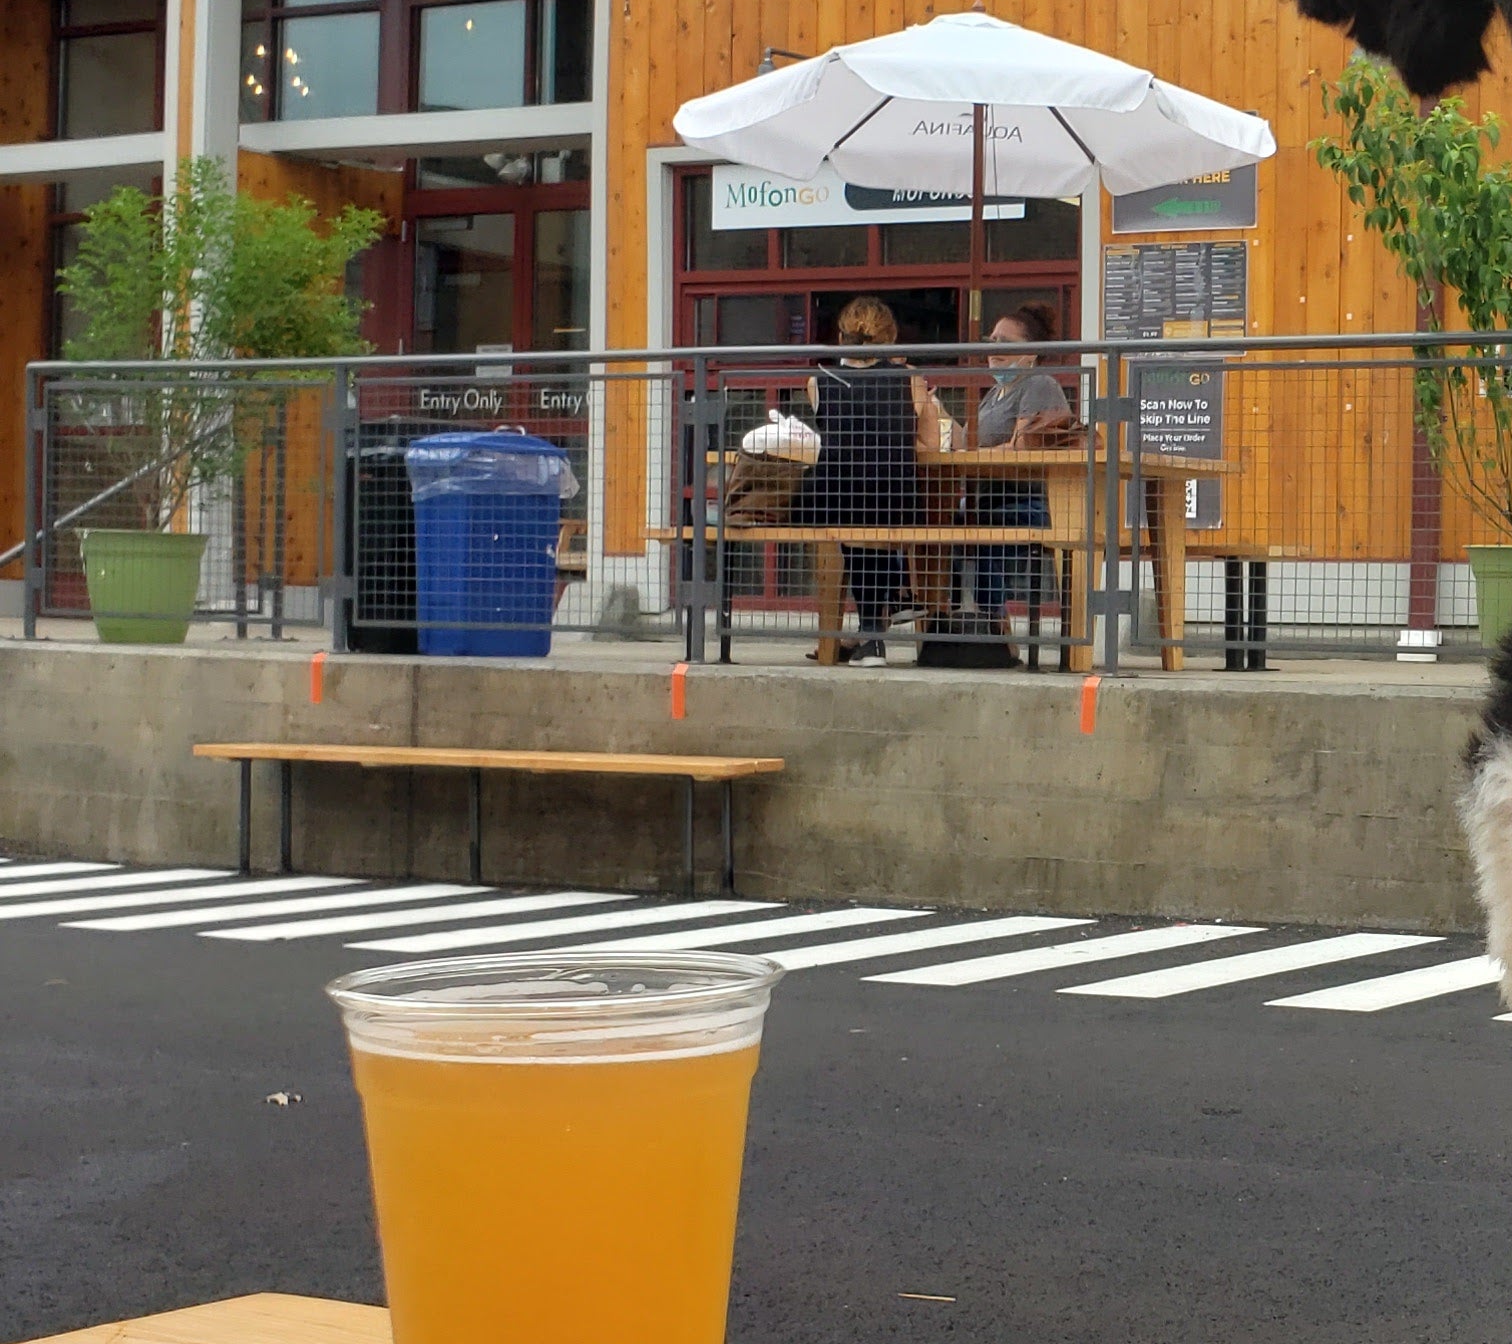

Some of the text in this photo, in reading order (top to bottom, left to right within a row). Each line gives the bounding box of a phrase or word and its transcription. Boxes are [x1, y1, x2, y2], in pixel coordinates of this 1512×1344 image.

[420, 387, 504, 416] Entry Only
[540, 387, 583, 415] Entry
[1140, 399, 1209, 411] Scan Now To
[1140, 413, 1211, 426] Skip The Line
[1183, 433, 1206, 442] Order
